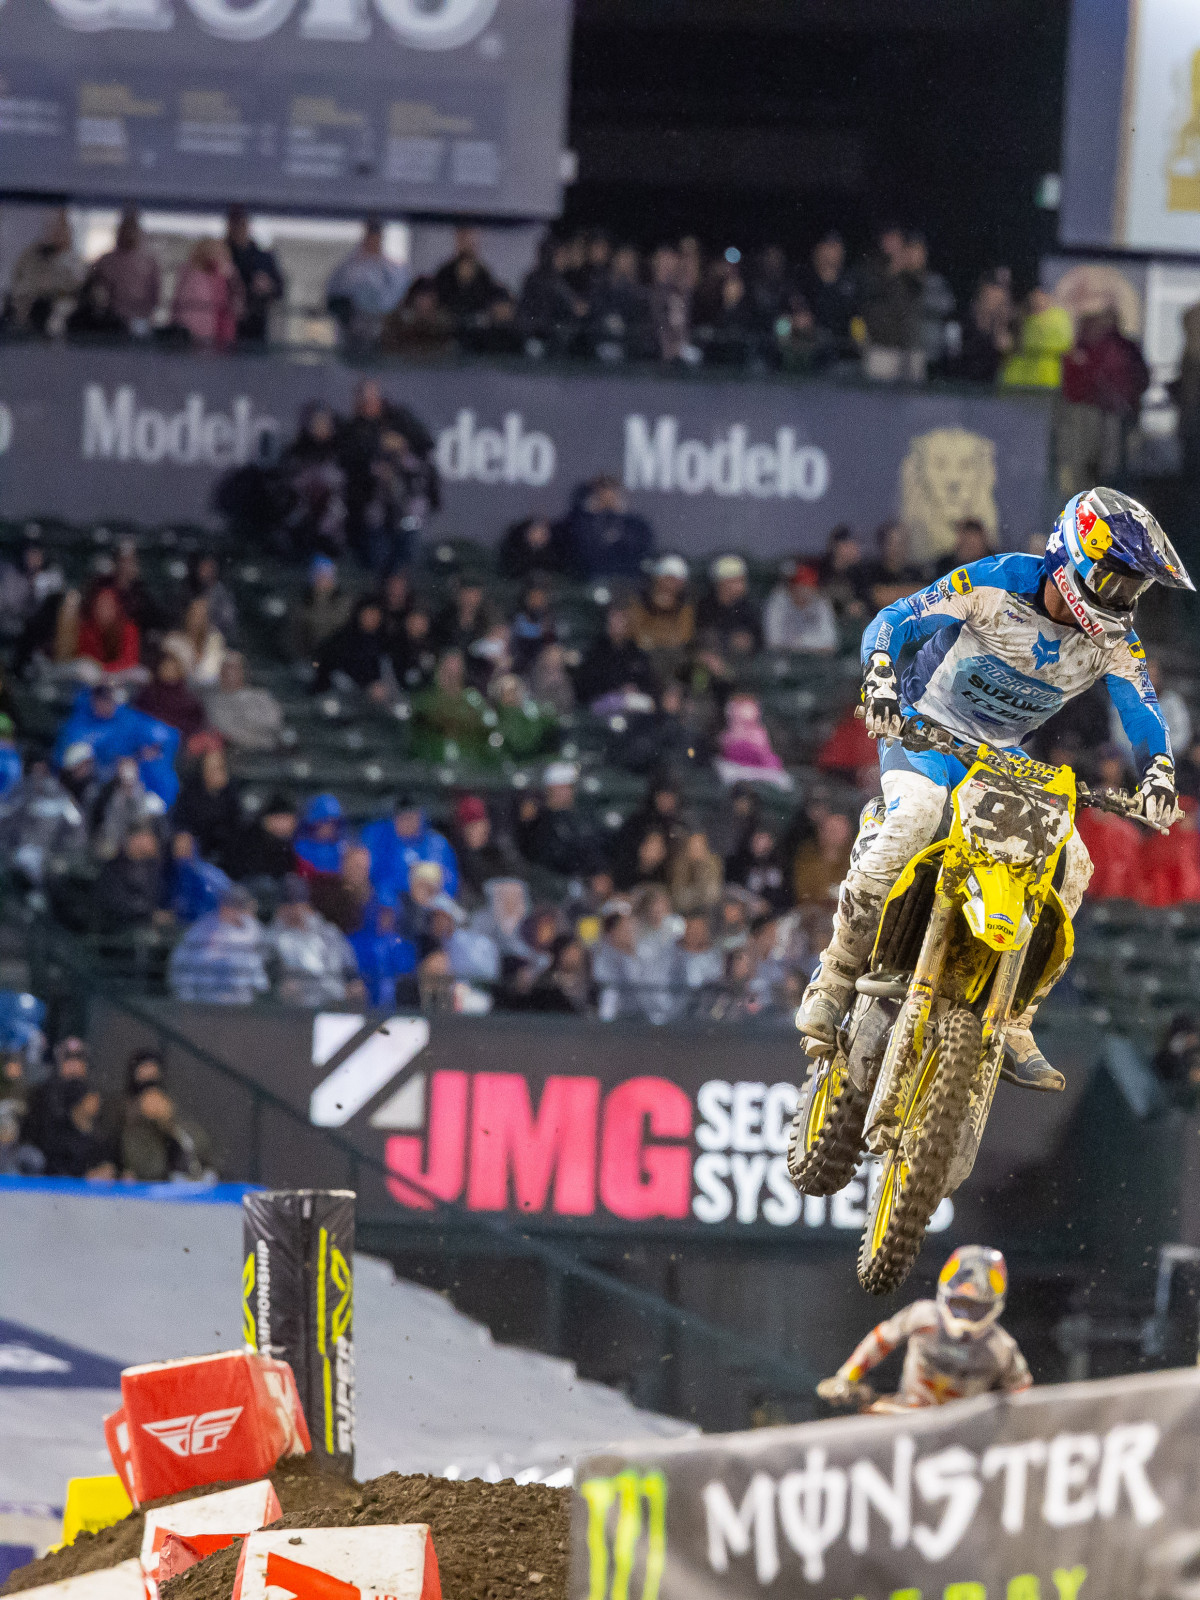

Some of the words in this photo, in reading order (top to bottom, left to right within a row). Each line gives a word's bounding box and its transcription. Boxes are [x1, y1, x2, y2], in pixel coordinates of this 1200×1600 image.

[436, 410, 556, 486] delo
[624, 413, 830, 501] Modelo
[1053, 566, 1078, 604] Red
[1073, 603, 1105, 637] Bull
[385, 1069, 693, 1221] JMG
[702, 1421, 1164, 1585] MONSTER
